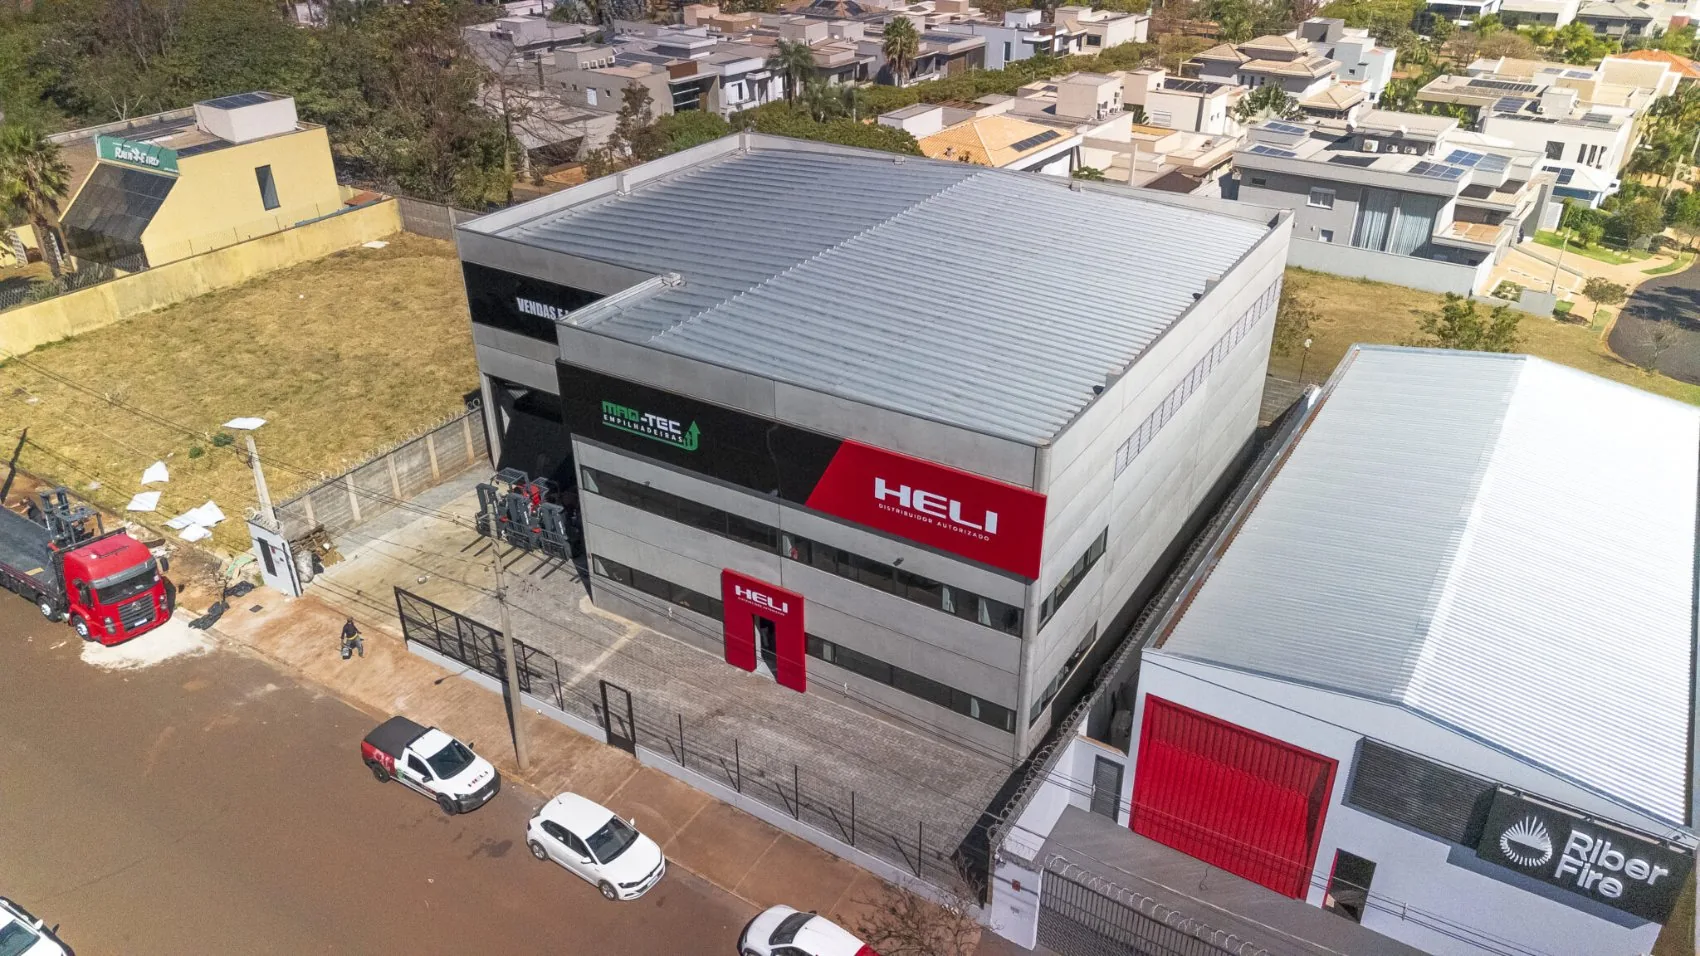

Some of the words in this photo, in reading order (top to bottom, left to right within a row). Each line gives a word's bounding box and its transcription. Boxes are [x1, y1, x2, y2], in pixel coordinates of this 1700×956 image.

[516, 297, 557, 320] VENDAS
[602, 400, 682, 435] MAQ-TEC
[603, 414, 683, 443] EMPILHADEIRAS
[874, 477, 998, 535] HELI
[878, 503, 933, 524] DISTRIBUIDOR
[936, 521, 990, 542] AUTORIZADO
[735, 584, 788, 614] HELI
[1554, 853, 1624, 898] Fire
[1563, 829, 1669, 886] Riber
